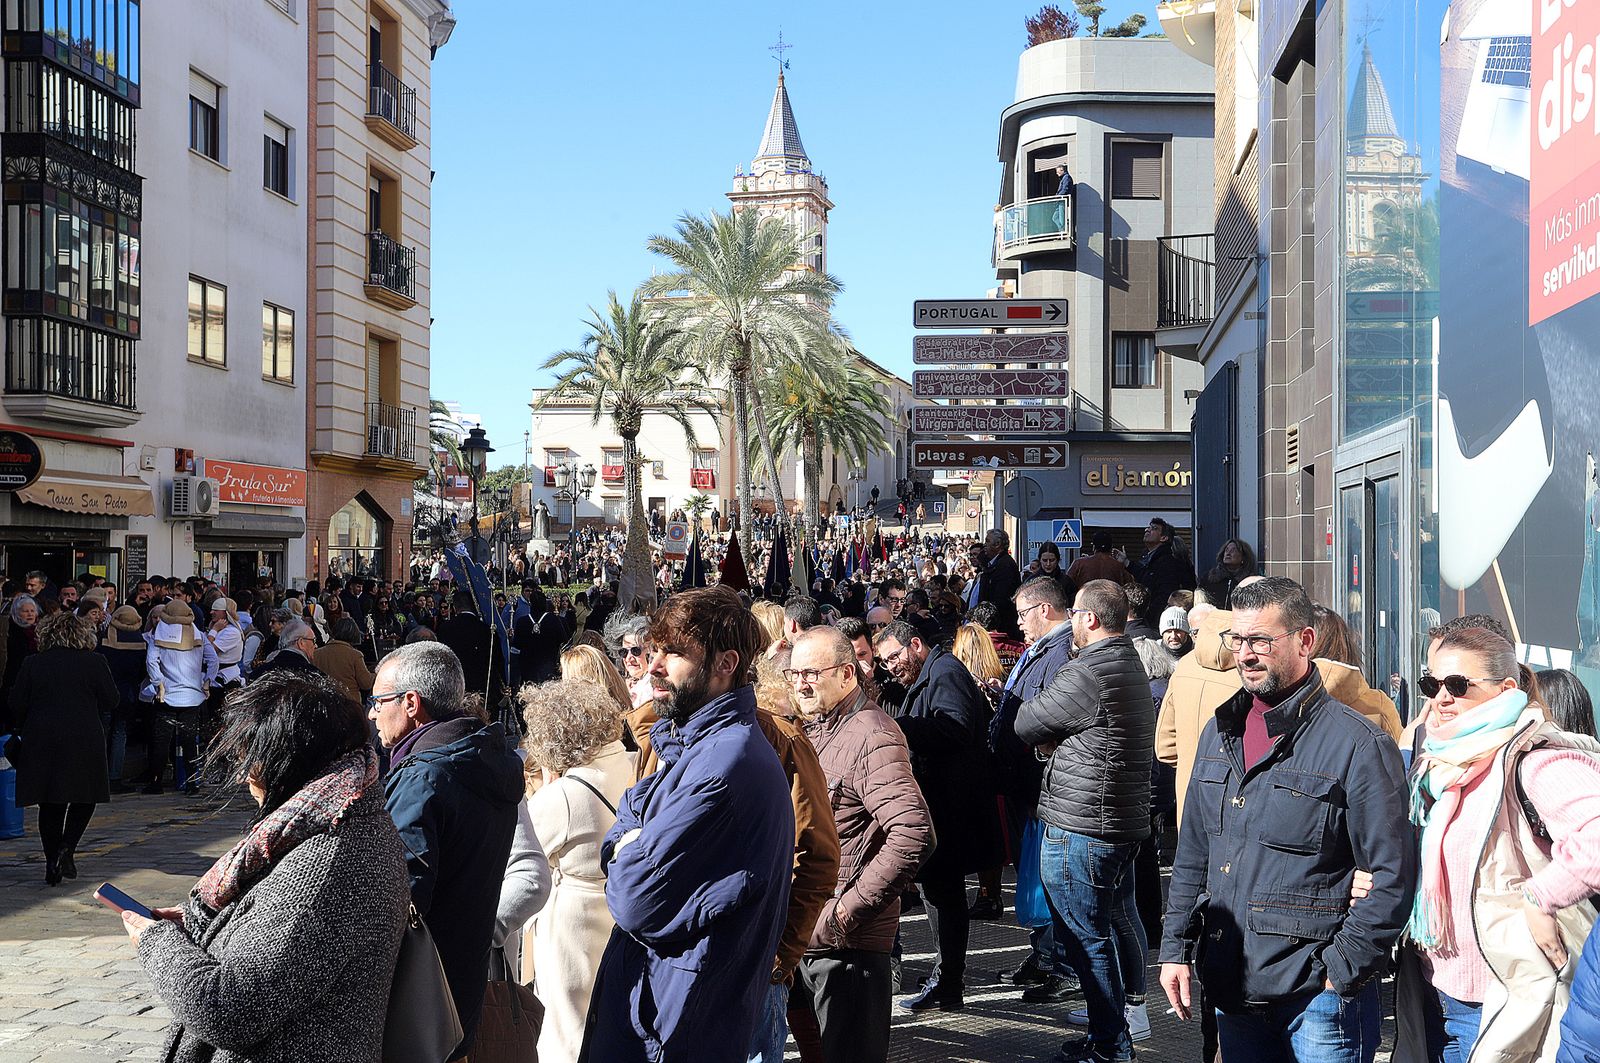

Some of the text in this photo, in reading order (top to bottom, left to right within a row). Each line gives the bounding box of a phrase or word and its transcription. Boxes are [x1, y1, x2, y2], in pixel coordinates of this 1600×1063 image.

[1545, 208, 1573, 251] Más
[919, 307, 999, 319] PORTUGAL
[919, 338, 981, 347] catedral de
[919, 347, 996, 359] La Merced
[919, 373, 977, 381] universidad
[919, 382, 995, 394] La Merced
[919, 409, 968, 417] santuario
[919, 418, 1021, 431] Virgen de la Cinta
[918, 449, 966, 463] playas
[212, 464, 293, 494] Fruta Sur
[1086, 463, 1110, 487] el
[47, 488, 128, 509] Tasca San Pedro
